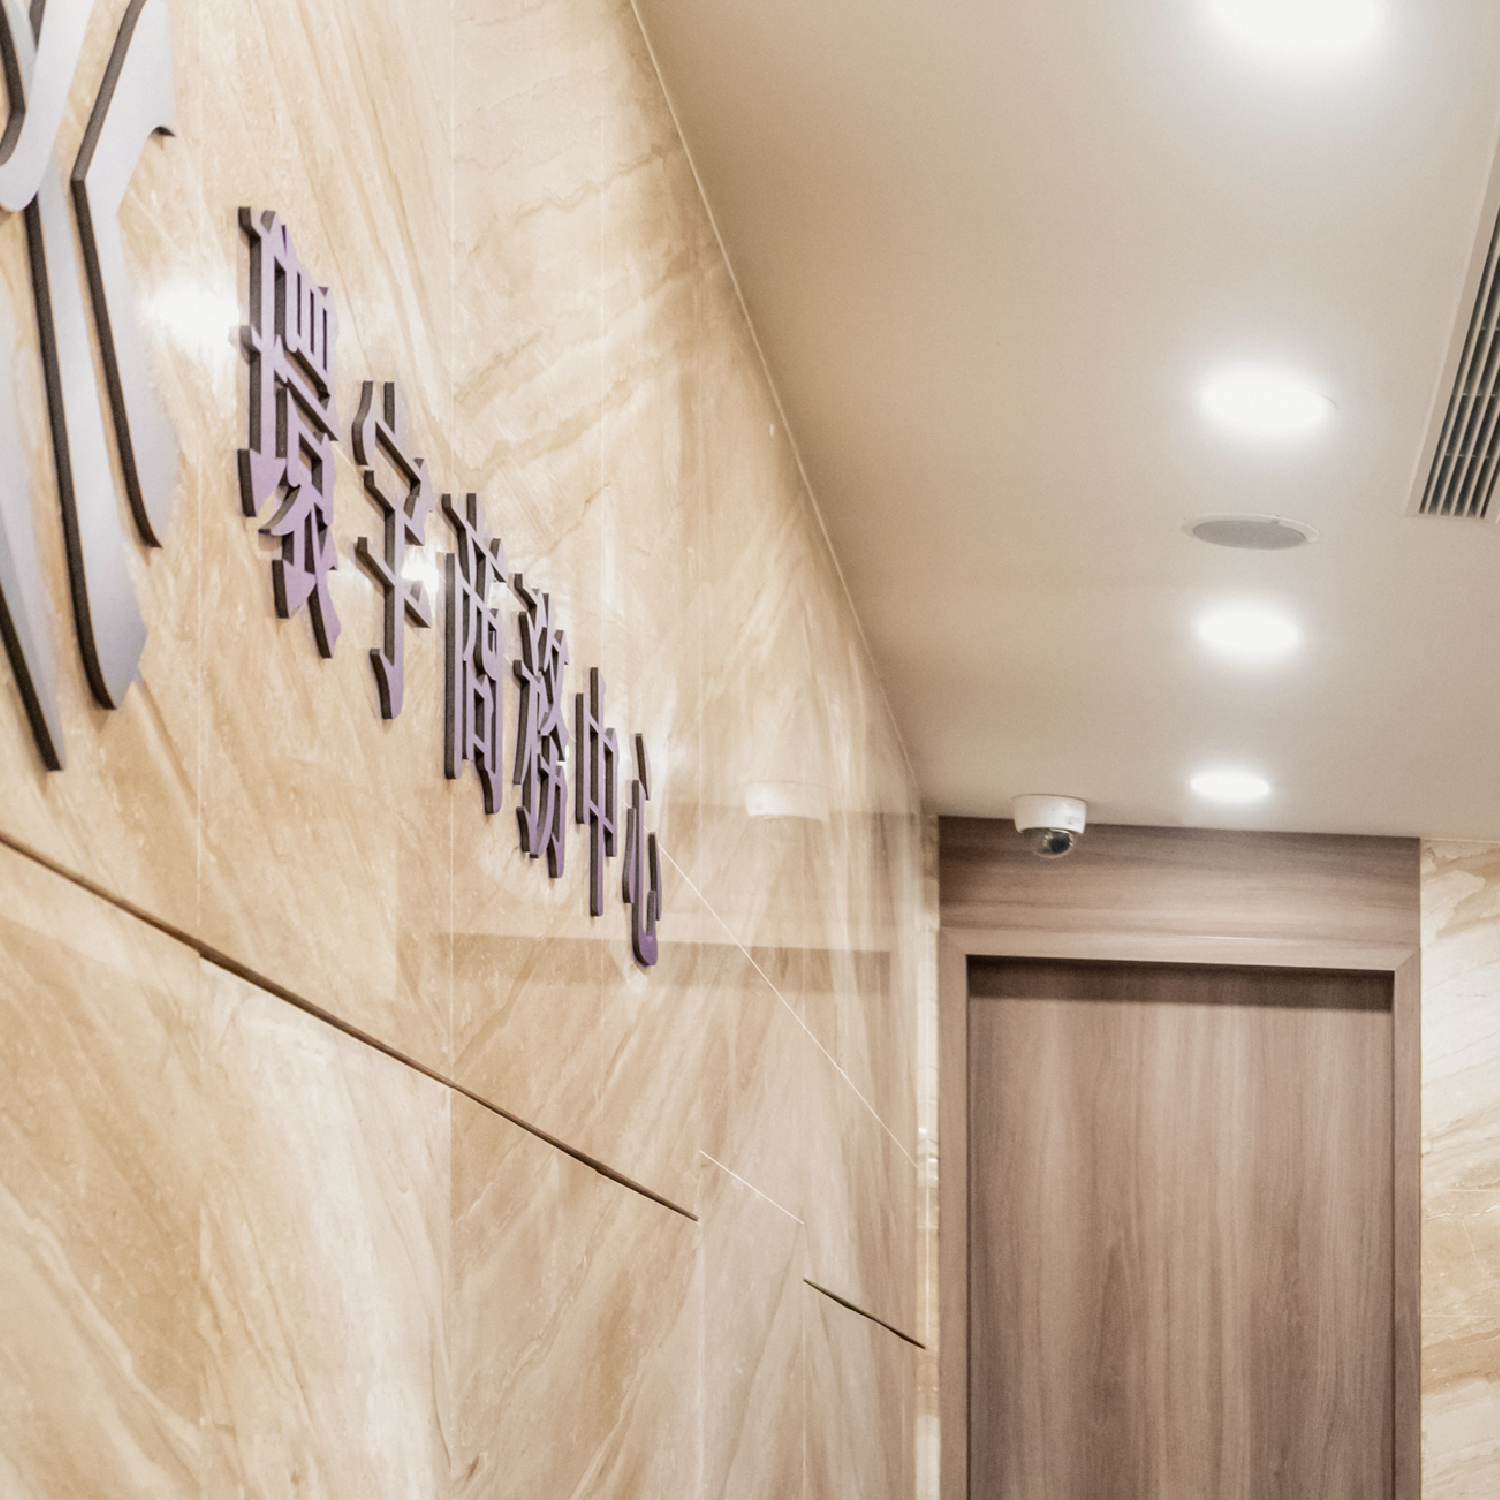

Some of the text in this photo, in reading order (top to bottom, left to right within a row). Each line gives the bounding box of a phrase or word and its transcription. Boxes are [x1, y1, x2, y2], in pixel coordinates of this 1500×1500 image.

[236, 205, 662, 966] 環宇商務中心
